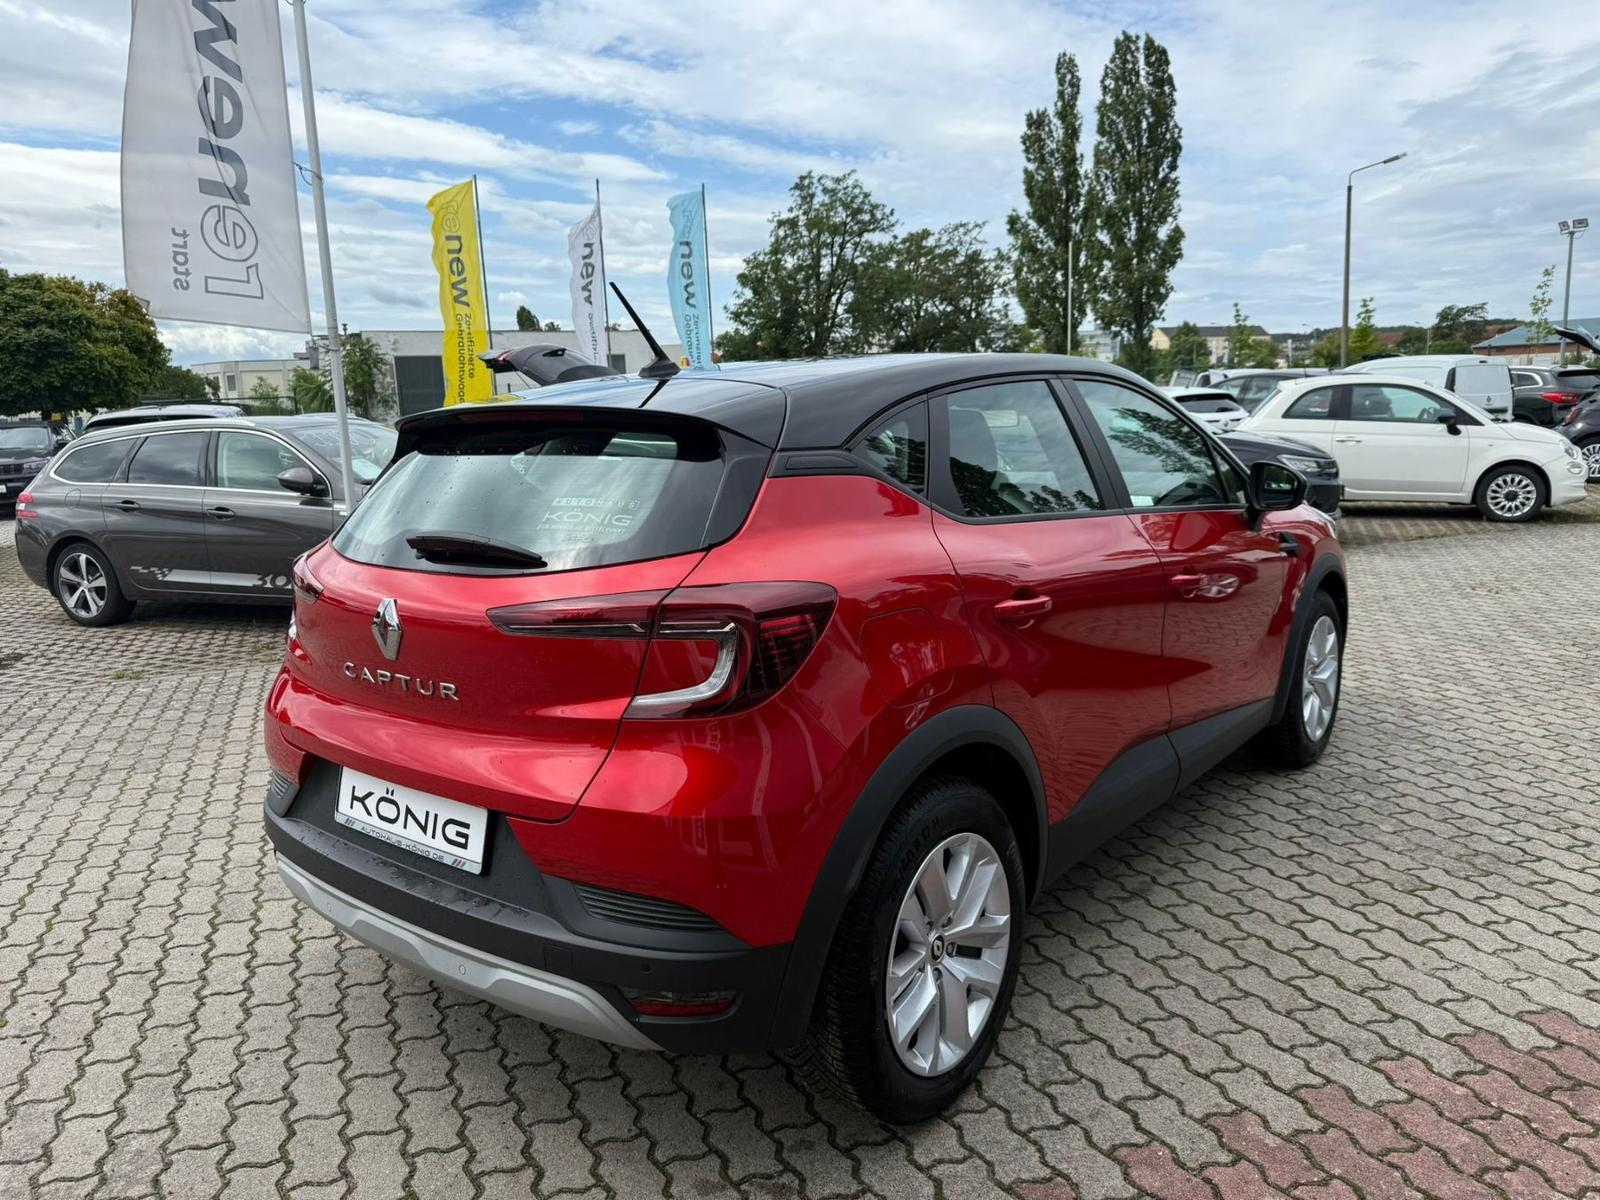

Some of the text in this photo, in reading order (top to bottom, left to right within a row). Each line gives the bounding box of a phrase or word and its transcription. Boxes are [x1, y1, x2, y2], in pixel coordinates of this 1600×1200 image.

[442, 200, 470, 307] renew
[543, 508, 633, 526] KÖNIG
[344, 662, 459, 701] CAPTUR
[350, 785, 471, 850] KÖNIG
